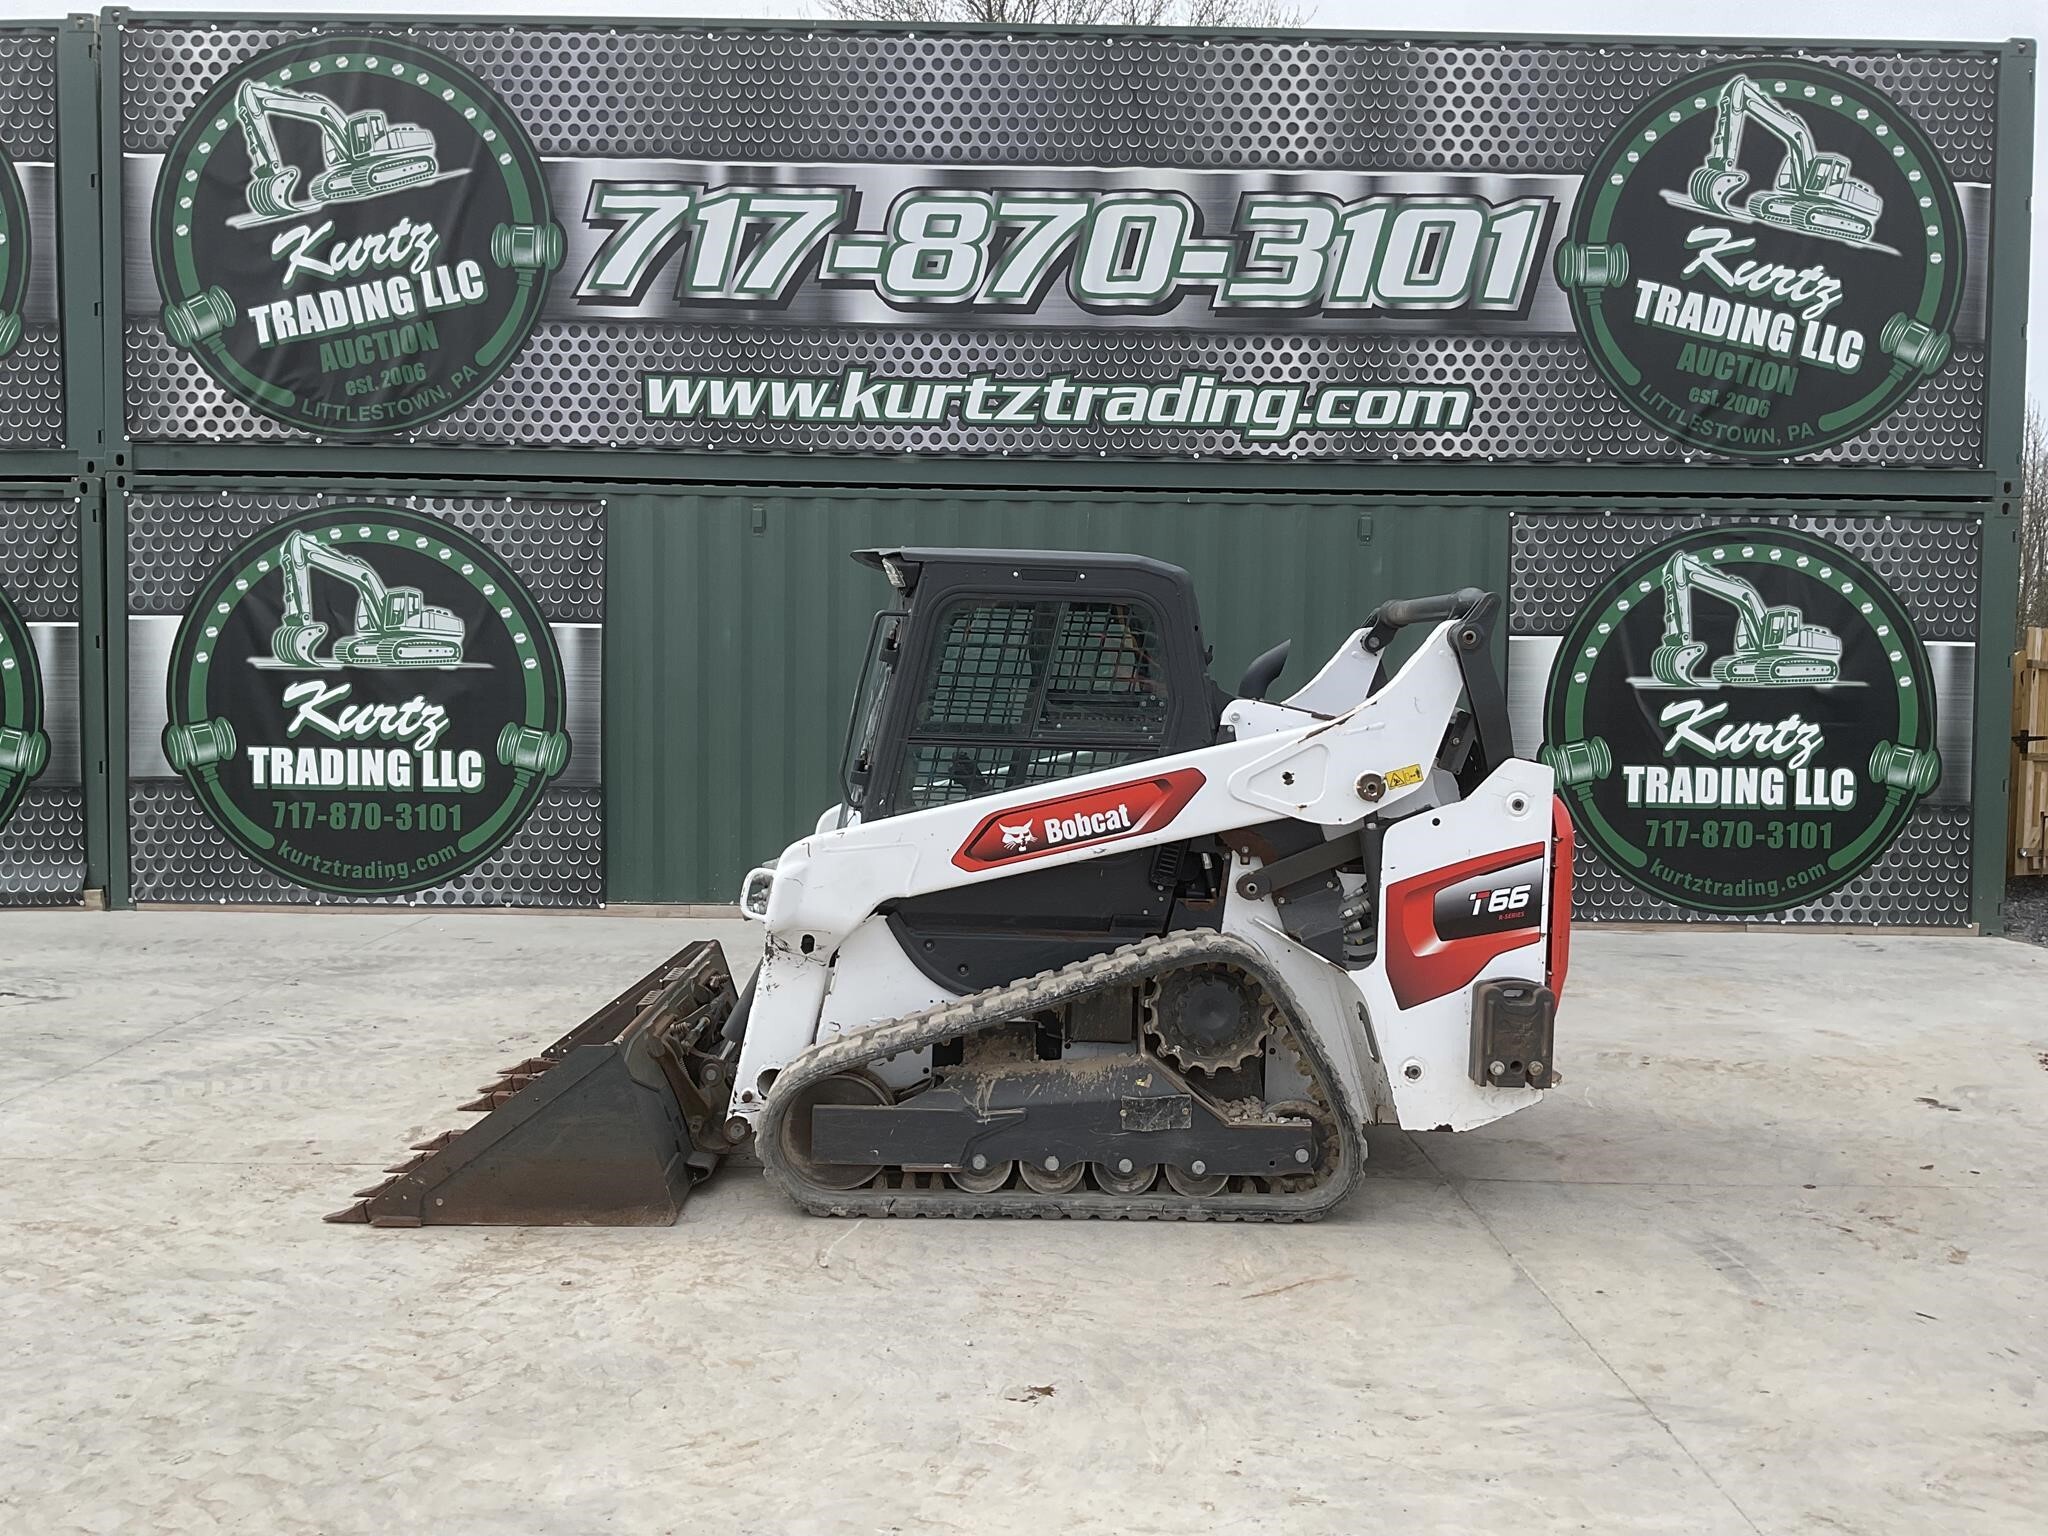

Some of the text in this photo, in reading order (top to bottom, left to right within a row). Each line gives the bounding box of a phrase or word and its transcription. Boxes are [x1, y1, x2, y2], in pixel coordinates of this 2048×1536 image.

[271, 217, 440, 288] Kurtz
[585, 186, 1545, 306] 717-870-3101
[1680, 226, 1843, 325] Kurtz
[248, 260, 488, 348] TRADING LLC
[1633, 279, 1866, 374] TRADING LLC
[319, 320, 439, 373] AUCTION
[1676, 342, 1799, 396] AUCTION
[302, 365, 479, 423] LITTLESTOWN, PA
[345, 362, 426, 396] est. 2006
[645, 369, 1472, 436] www.kurtztrading.com
[1689, 386, 1771, 418] est. 2006
[1639, 384, 1815, 445] LITTLESTOWN, PA
[282, 680, 450, 757] Kurtz
[1659, 700, 1825, 775] Kurtz
[247, 746, 486, 793] TRADING LLC
[1623, 766, 1857, 811] TRADING LLC
[272, 801, 462, 832] 717-870-3101
[1044, 803, 1131, 844] Bobcat
[1646, 820, 1832, 849] 717-870-3101
[277, 840, 458, 880] kurtztrading.com
[1649, 858, 1827, 897] kurtztrading.com
[1469, 884, 1532, 915] T66
